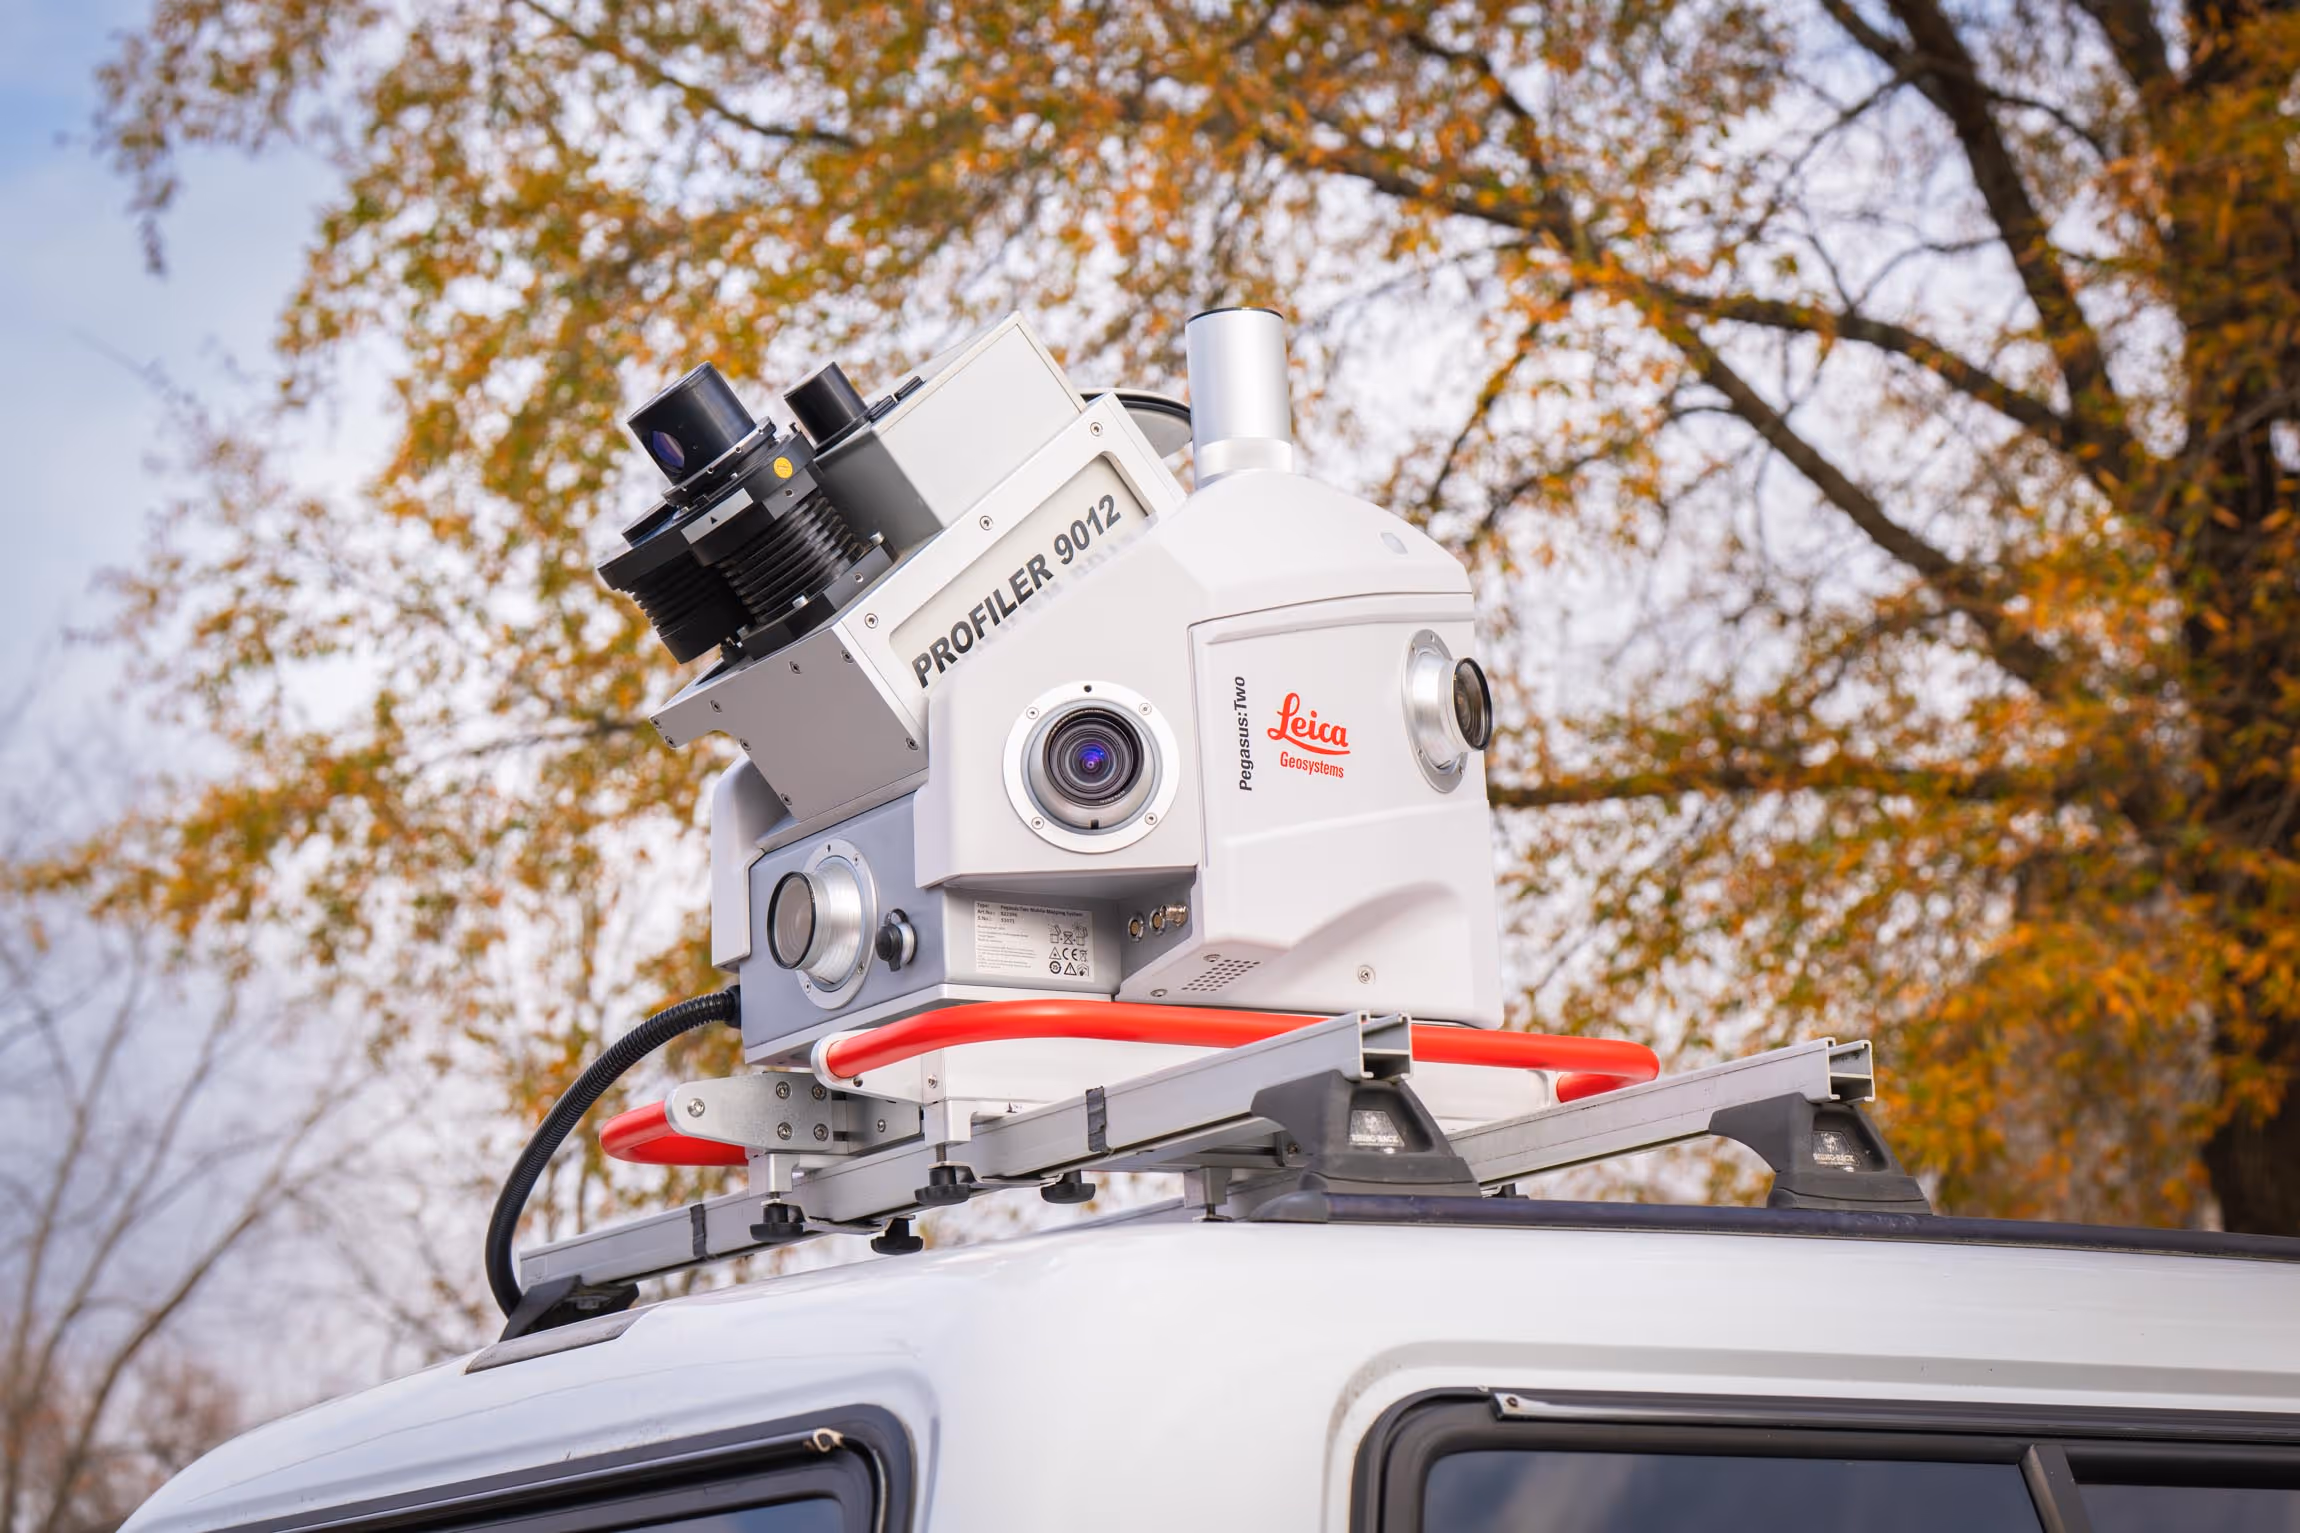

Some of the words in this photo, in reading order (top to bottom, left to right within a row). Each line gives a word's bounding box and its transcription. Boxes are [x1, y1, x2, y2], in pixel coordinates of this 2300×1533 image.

[911, 553, 1054, 688] PROFILER
[1054, 494, 1121, 565] 9012
[1234, 676, 1254, 791] Pegasus:Two
[1267, 692, 1351, 755] Leica
[1280, 751, 1345, 779] Geosystems
